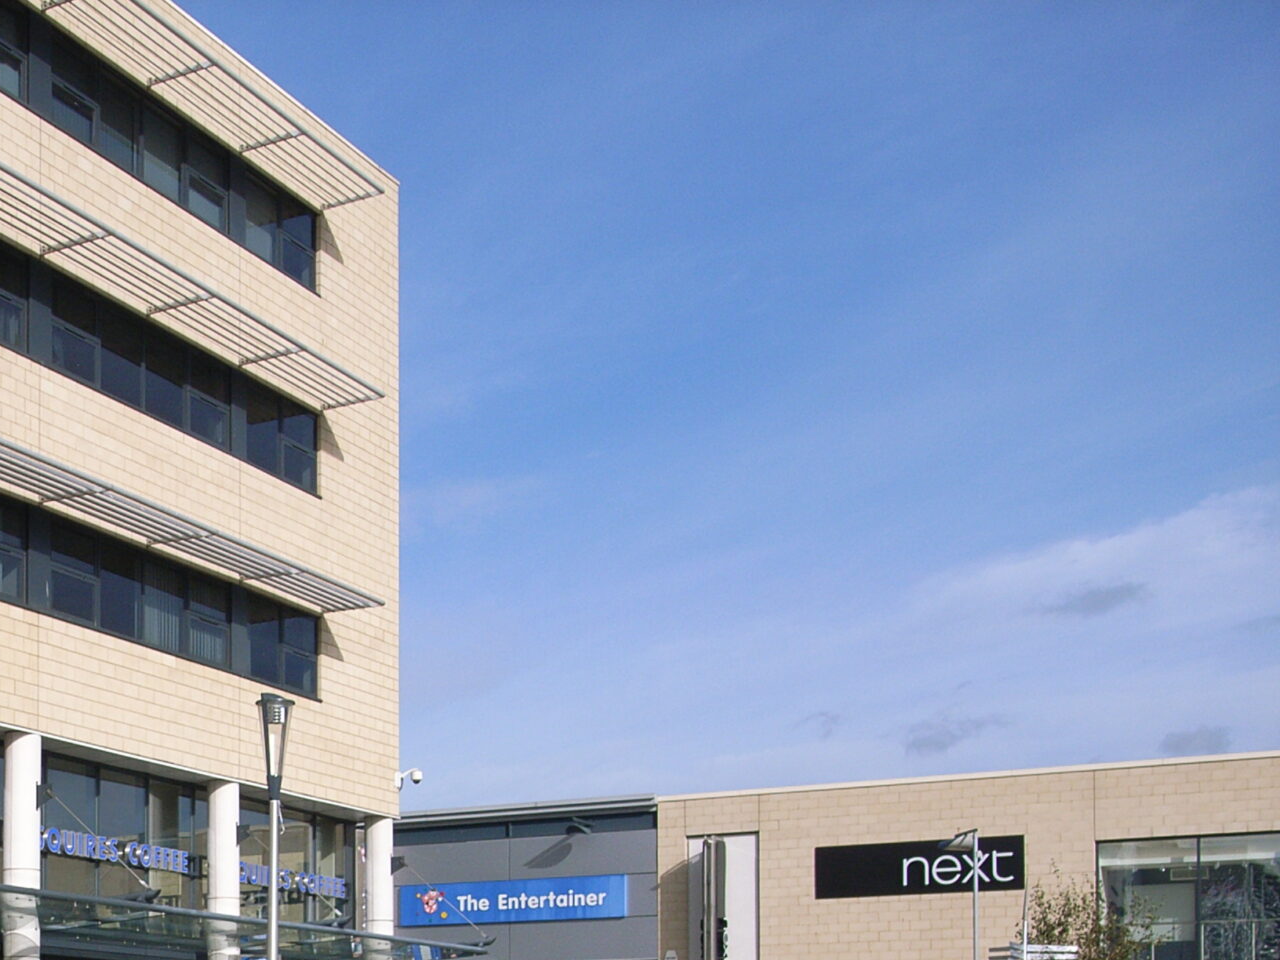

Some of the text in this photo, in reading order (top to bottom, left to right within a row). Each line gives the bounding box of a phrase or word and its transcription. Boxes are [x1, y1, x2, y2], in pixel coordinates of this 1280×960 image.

[128, 841, 189, 873] COFFEE
[902, 849, 1015, 887] next
[456, 889, 607, 912] The Entertainer
